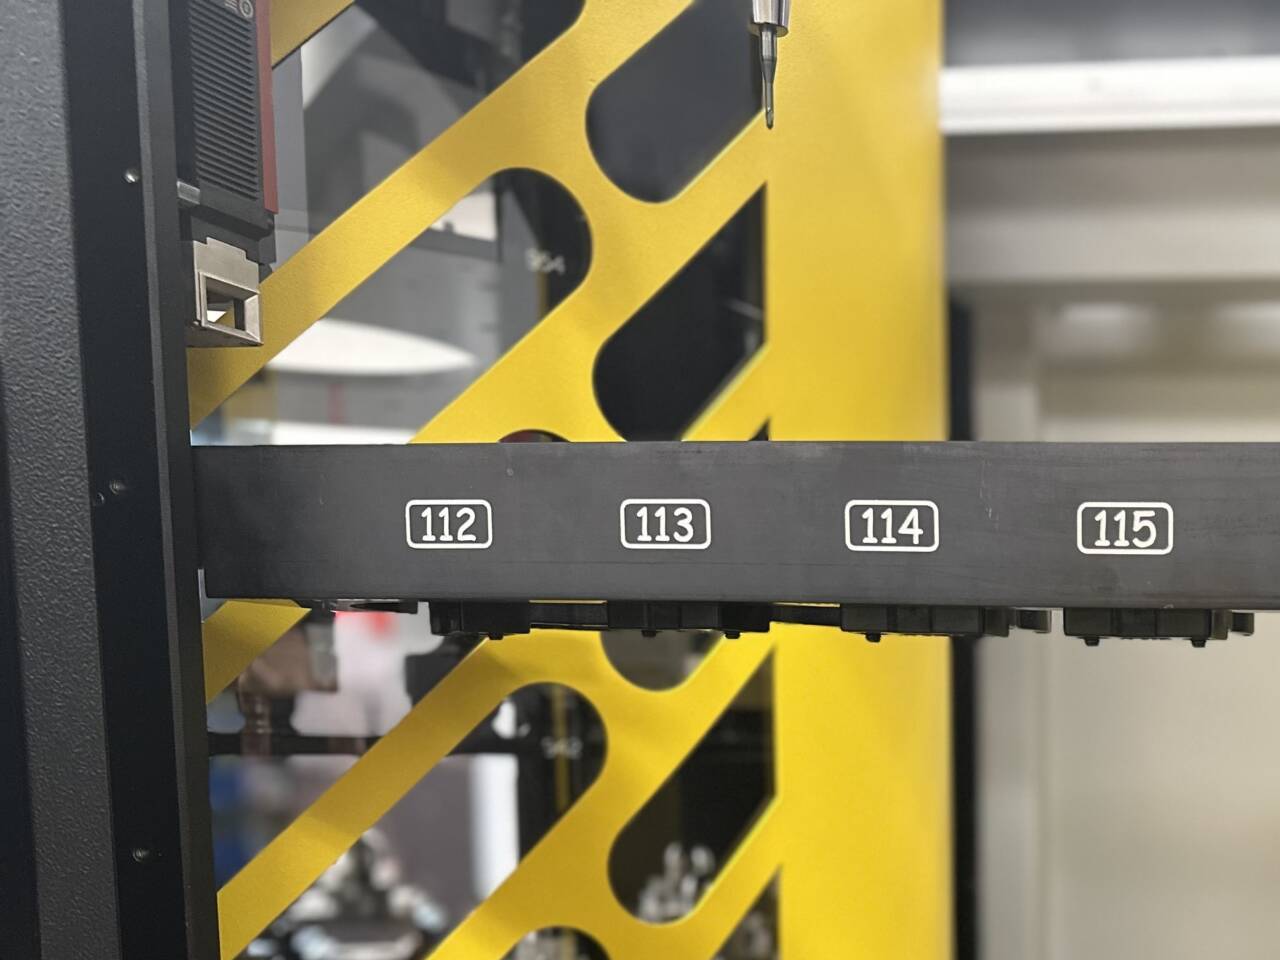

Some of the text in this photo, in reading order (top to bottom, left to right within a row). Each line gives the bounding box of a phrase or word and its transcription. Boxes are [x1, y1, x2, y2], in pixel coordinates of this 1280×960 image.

[421, 506, 477, 542] 112
[637, 505, 694, 543] 113
[862, 507, 924, 545] 114
[1094, 508, 1157, 549] 115
